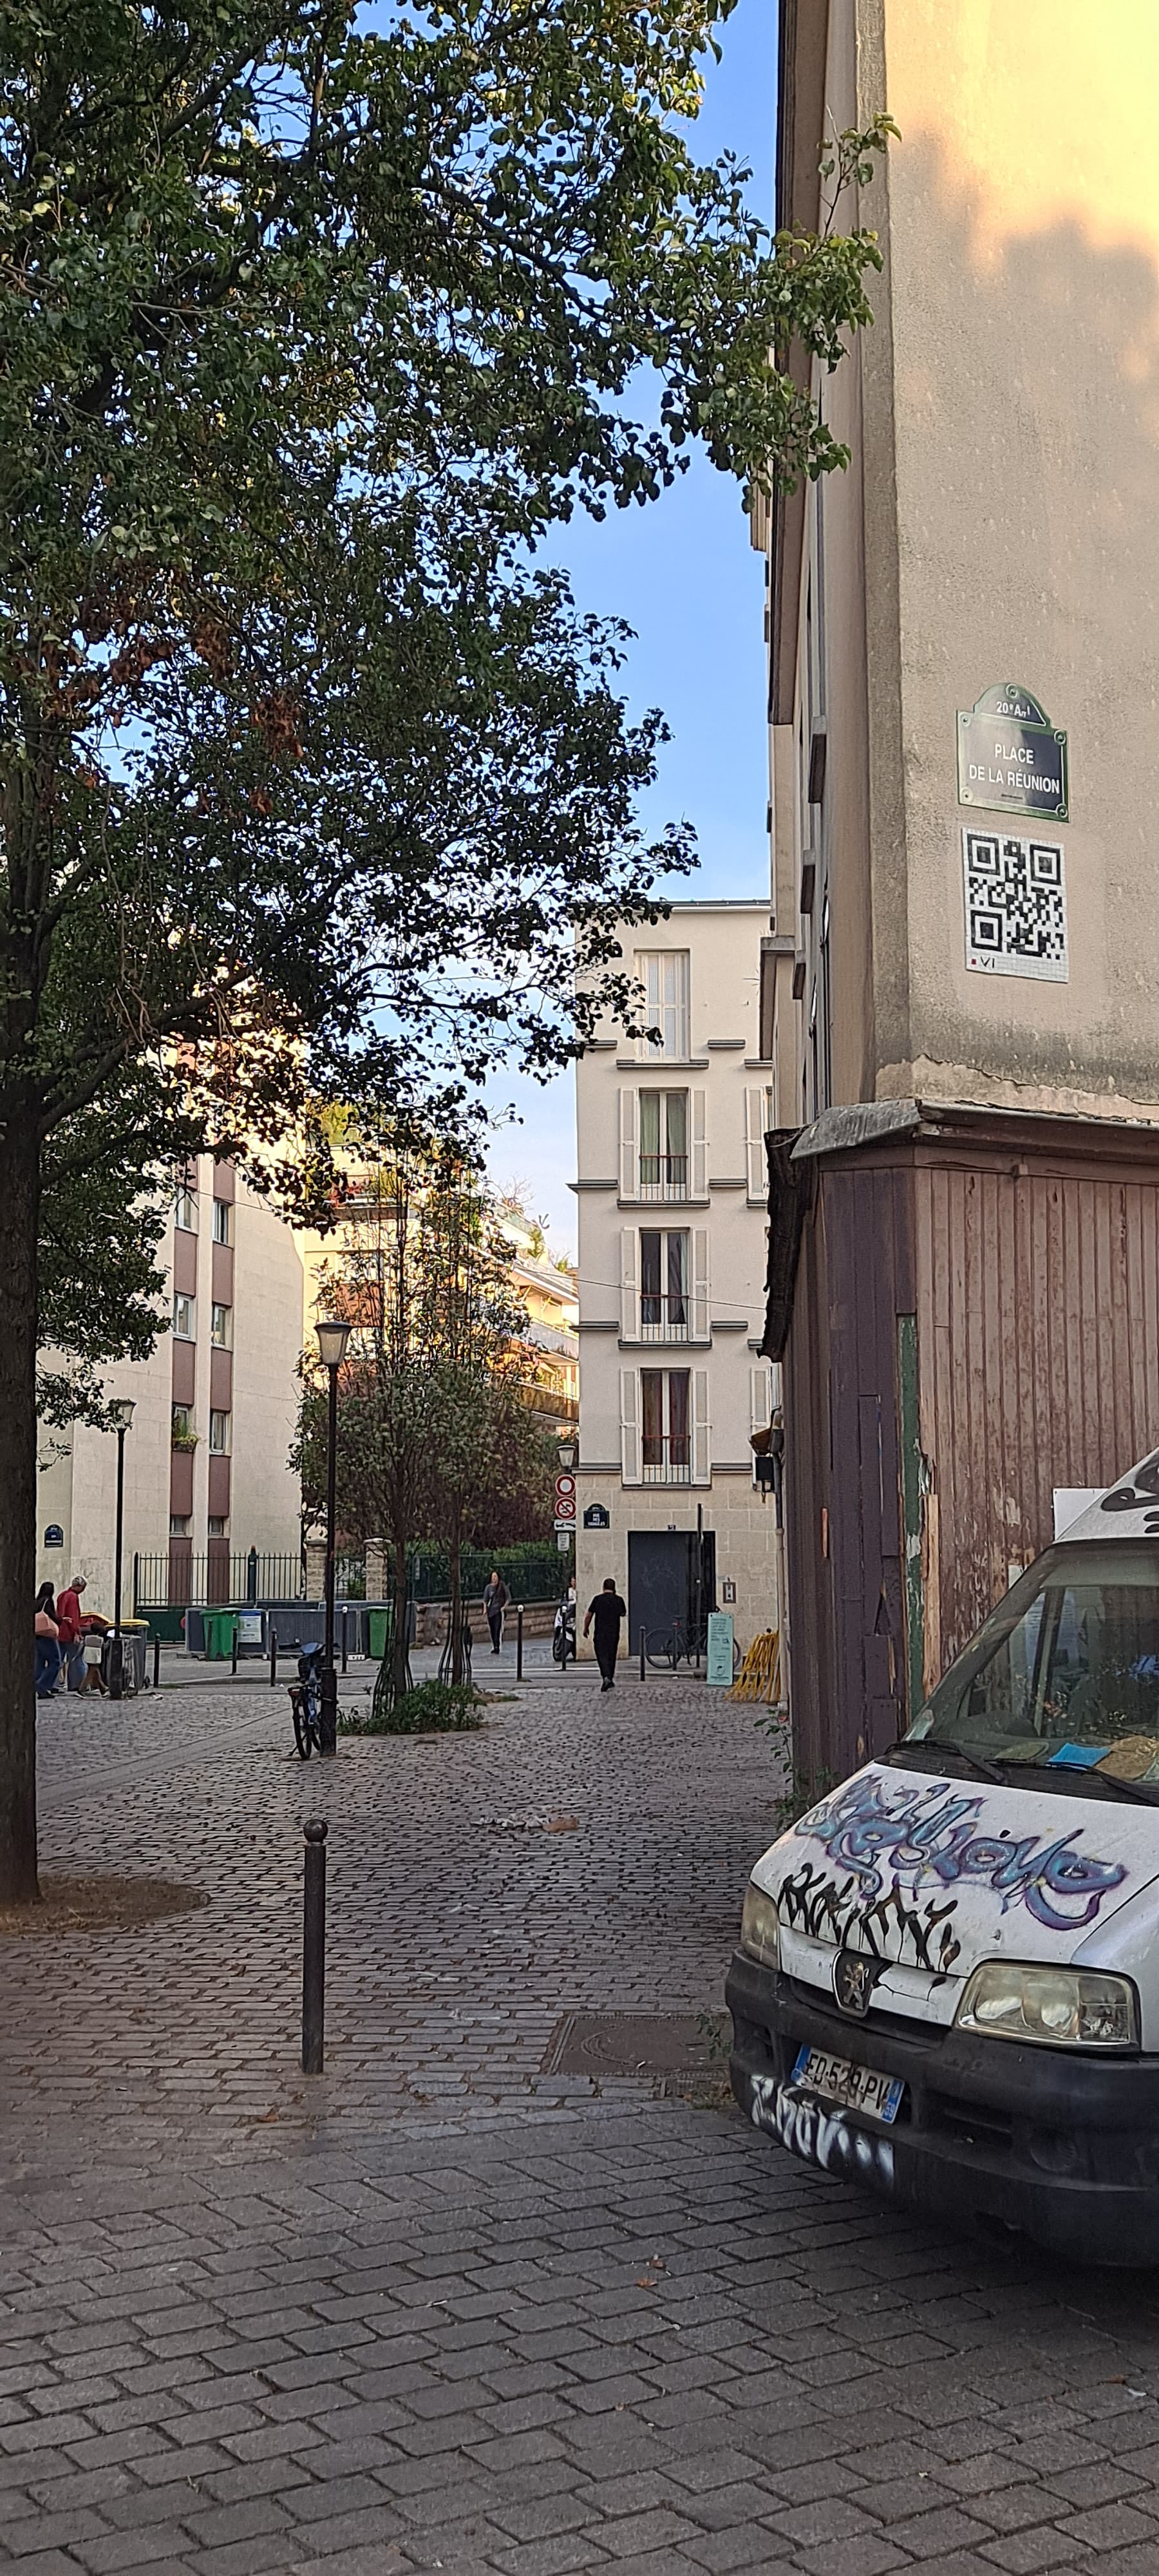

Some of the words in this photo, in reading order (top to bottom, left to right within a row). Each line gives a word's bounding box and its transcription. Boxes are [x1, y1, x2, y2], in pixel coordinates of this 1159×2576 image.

[995, 743, 1034, 764] PLACE
[969, 764, 985, 781] DE
[989, 767, 1003, 784] LA
[1007, 769, 1060, 794] RÉUNION
